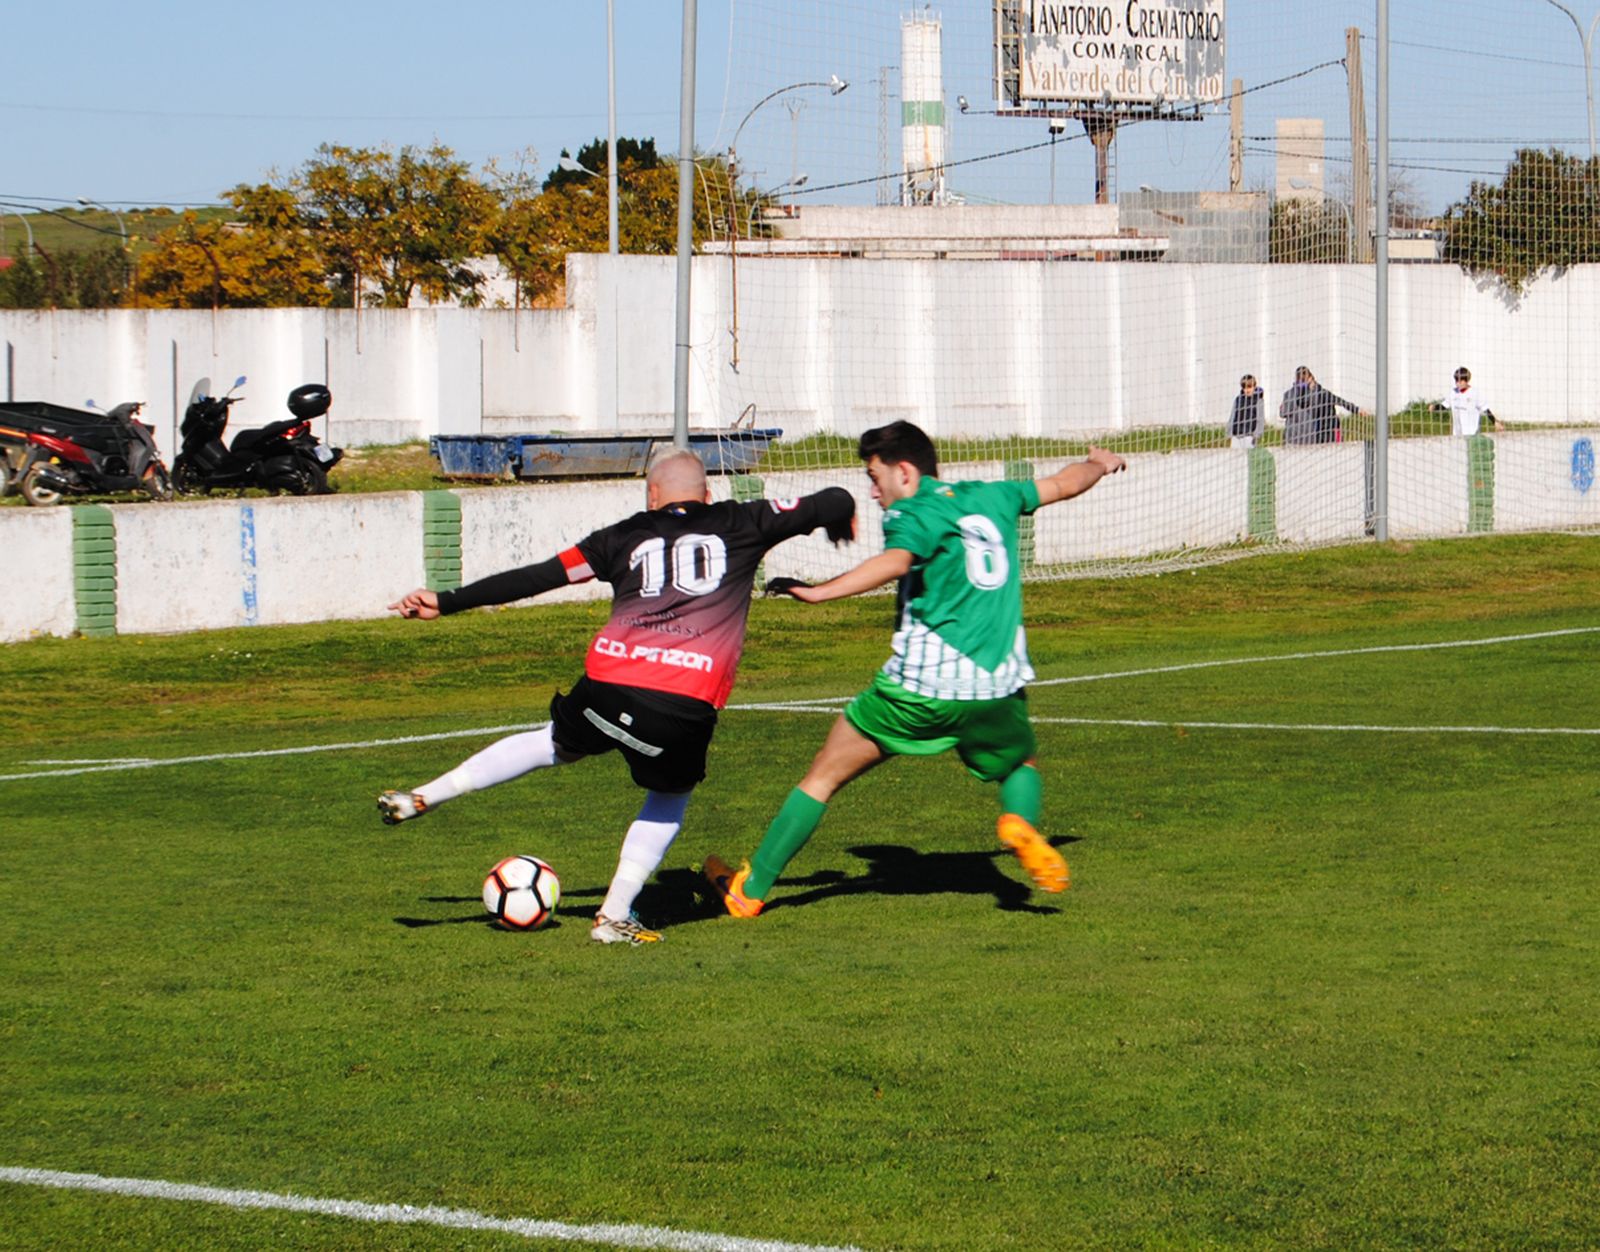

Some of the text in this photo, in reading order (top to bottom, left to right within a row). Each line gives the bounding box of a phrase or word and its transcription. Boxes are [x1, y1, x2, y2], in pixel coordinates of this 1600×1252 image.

[1126, 0, 1220, 42] CREMATORIO
[1072, 41, 1181, 63] COMARCAL
[1027, 61, 1220, 97] Valverde del Camno
[628, 533, 728, 598] 10
[956, 513, 1010, 591] 8
[594, 636, 628, 659] C.D.
